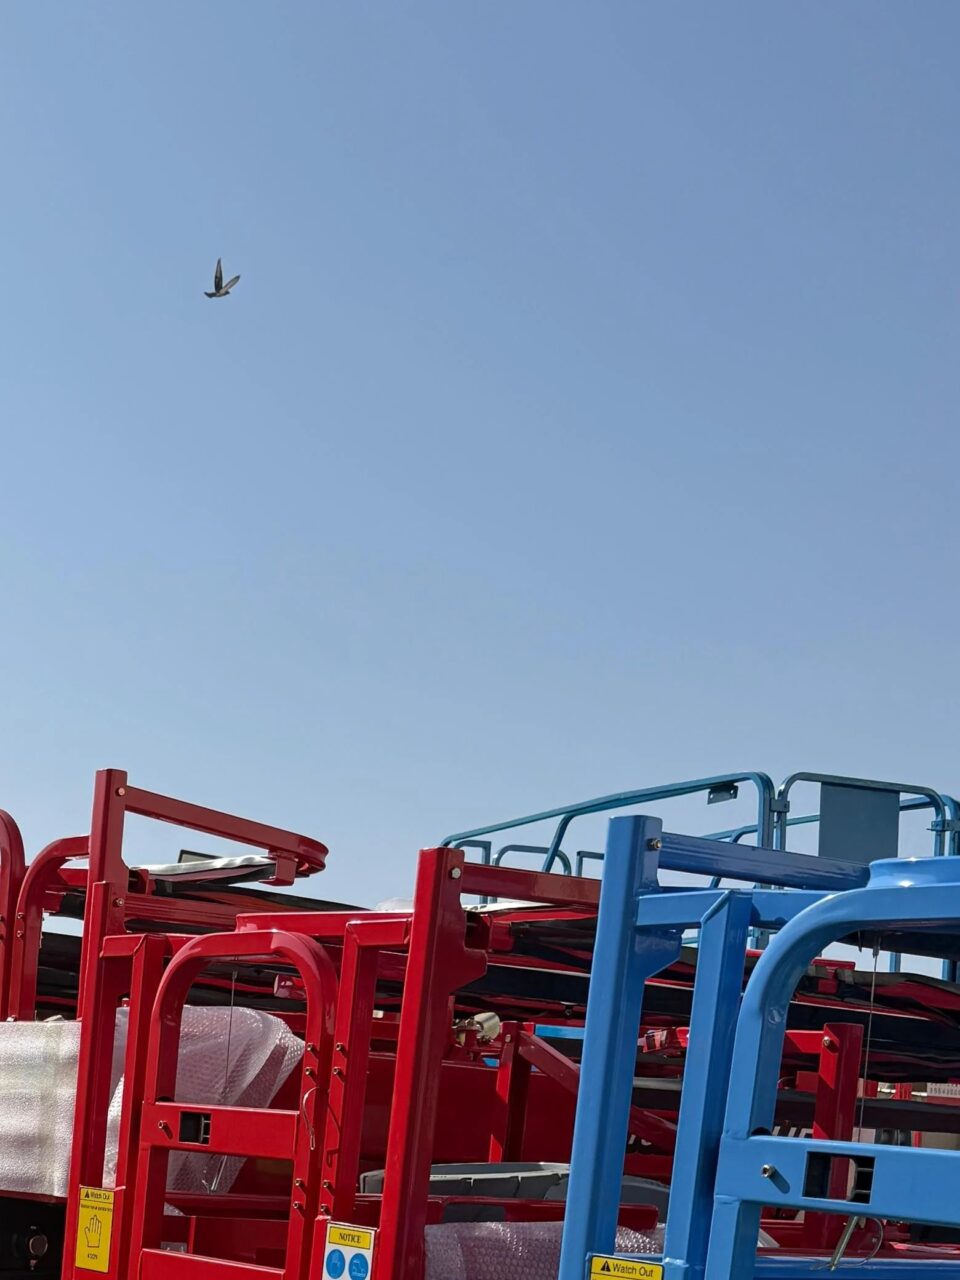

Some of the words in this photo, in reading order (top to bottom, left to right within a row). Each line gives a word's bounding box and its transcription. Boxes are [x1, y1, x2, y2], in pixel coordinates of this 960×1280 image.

[339, 1232, 362, 1244] NOTICE
[613, 1262, 637, 1275] Watch
[639, 1266, 654, 1277] Out
